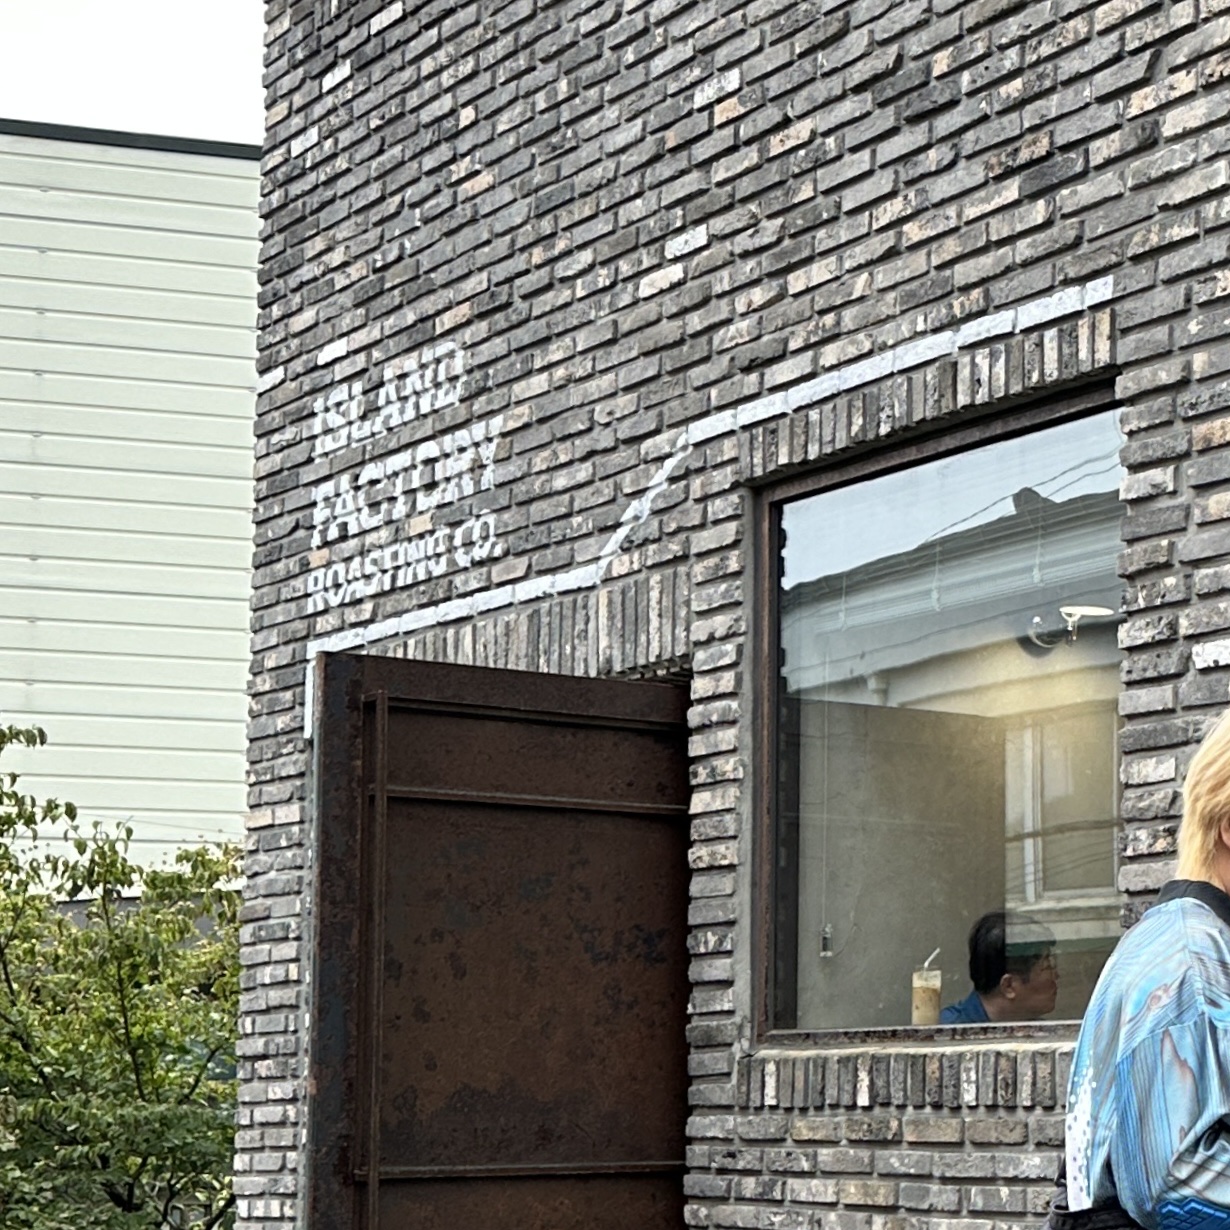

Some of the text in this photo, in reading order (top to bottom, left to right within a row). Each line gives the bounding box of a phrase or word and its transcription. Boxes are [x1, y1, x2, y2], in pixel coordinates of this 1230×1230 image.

[312, 341, 466, 464] ISLAND
[311, 415, 504, 551] FACTORY
[307, 509, 504, 614] ROASTING CO.
